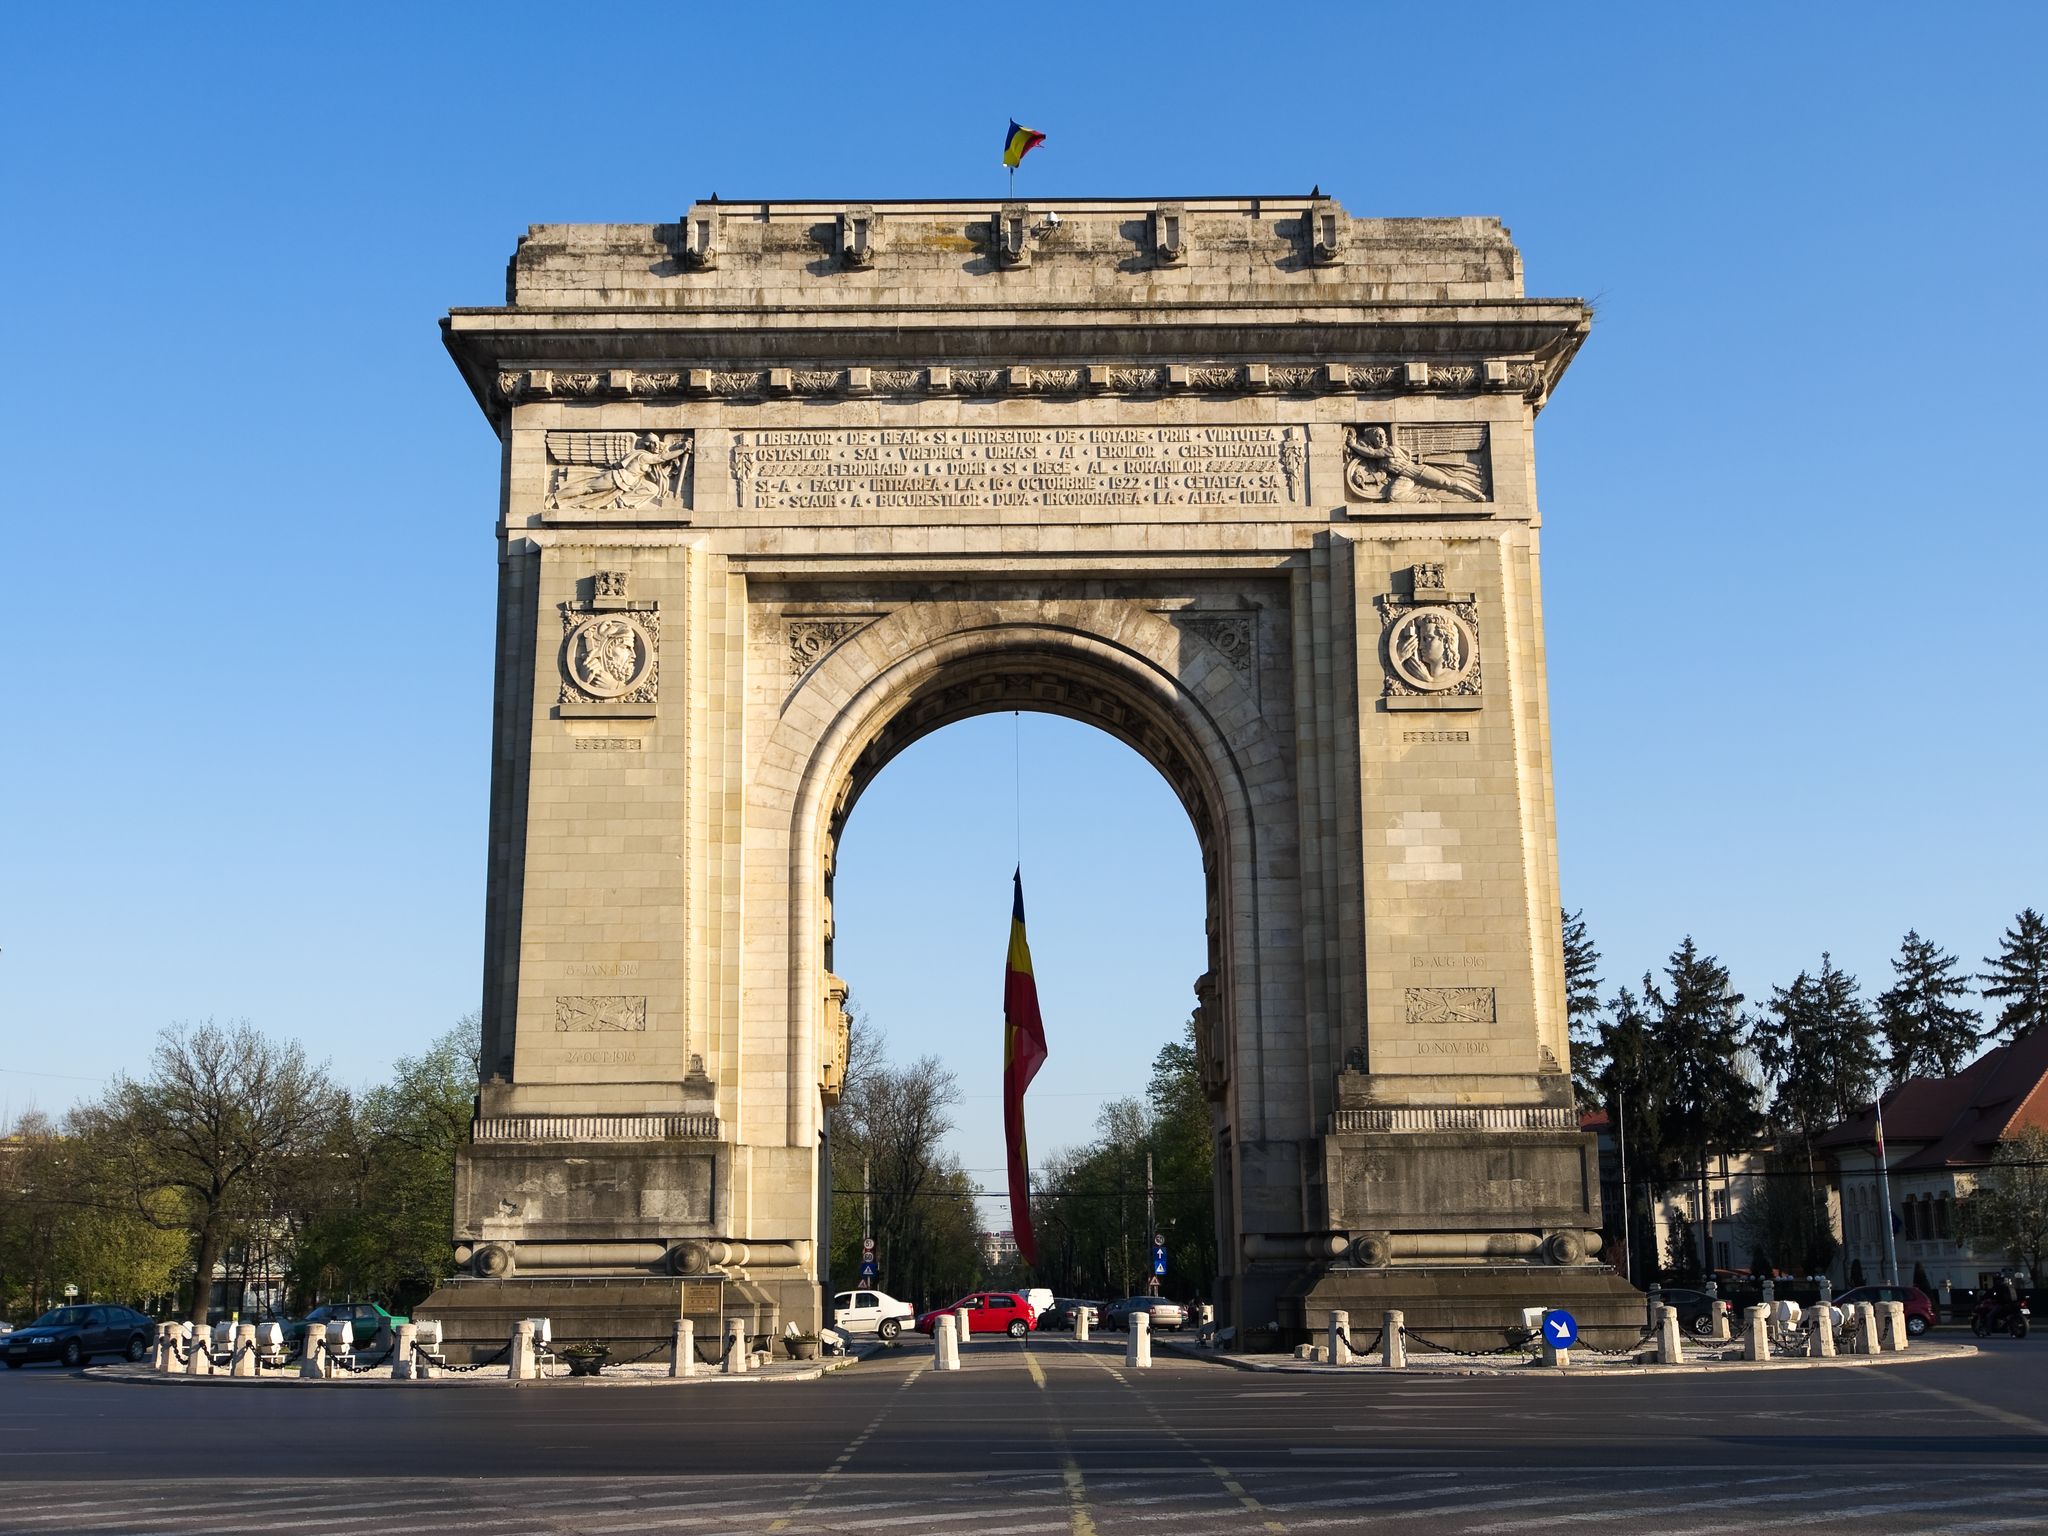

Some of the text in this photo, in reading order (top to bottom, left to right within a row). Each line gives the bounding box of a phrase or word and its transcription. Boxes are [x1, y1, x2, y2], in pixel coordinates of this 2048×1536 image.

[756, 429, 1277, 446] LIBERATOR DE NEAM SI INTREGITOR DE HOTARE PRIN VIRTUTEA
[756, 448, 832, 461] OSTASILOR
[854, 448, 879, 460] SAI
[899, 447, 964, 460] VREDNICI
[1059, 446, 1075, 459] AI
[1096, 445, 1155, 458] EROILOR
[827, 463, 906, 476] FERDINAND
[947, 462, 987, 475] DOMN
[1003, 462, 1018, 475] SI
[1033, 461, 1071, 474] REGE
[1087, 461, 1108, 474] AL
[1124, 460, 1203, 474] ROMANILOR
[810, 479, 856, 492] FACUT
[870, 478, 942, 492] INTRAREA
[954, 478, 977, 491] LA
[989, 478, 1004, 490] 16
[1018, 477, 1096, 490] OCTOMBRIE
[1109, 476, 1141, 490] 1922
[1154, 476, 1170, 489] IN
[1184, 475, 1247, 489] CETATEA
[1259, 475, 1280, 488] SA
[755, 495, 776, 508] DE
[789, 495, 838, 508] SCAUN
[850, 494, 863, 507] A
[876, 494, 981, 507] BUCURESTILOR
[993, 493, 1031, 506] DUPA
[1043, 492, 1142, 506] INCORONAREA
[1153, 492, 1176, 504] LA
[1417, 1042, 1429, 1054] 10
[1434, 1042, 1461, 1054] NOV
